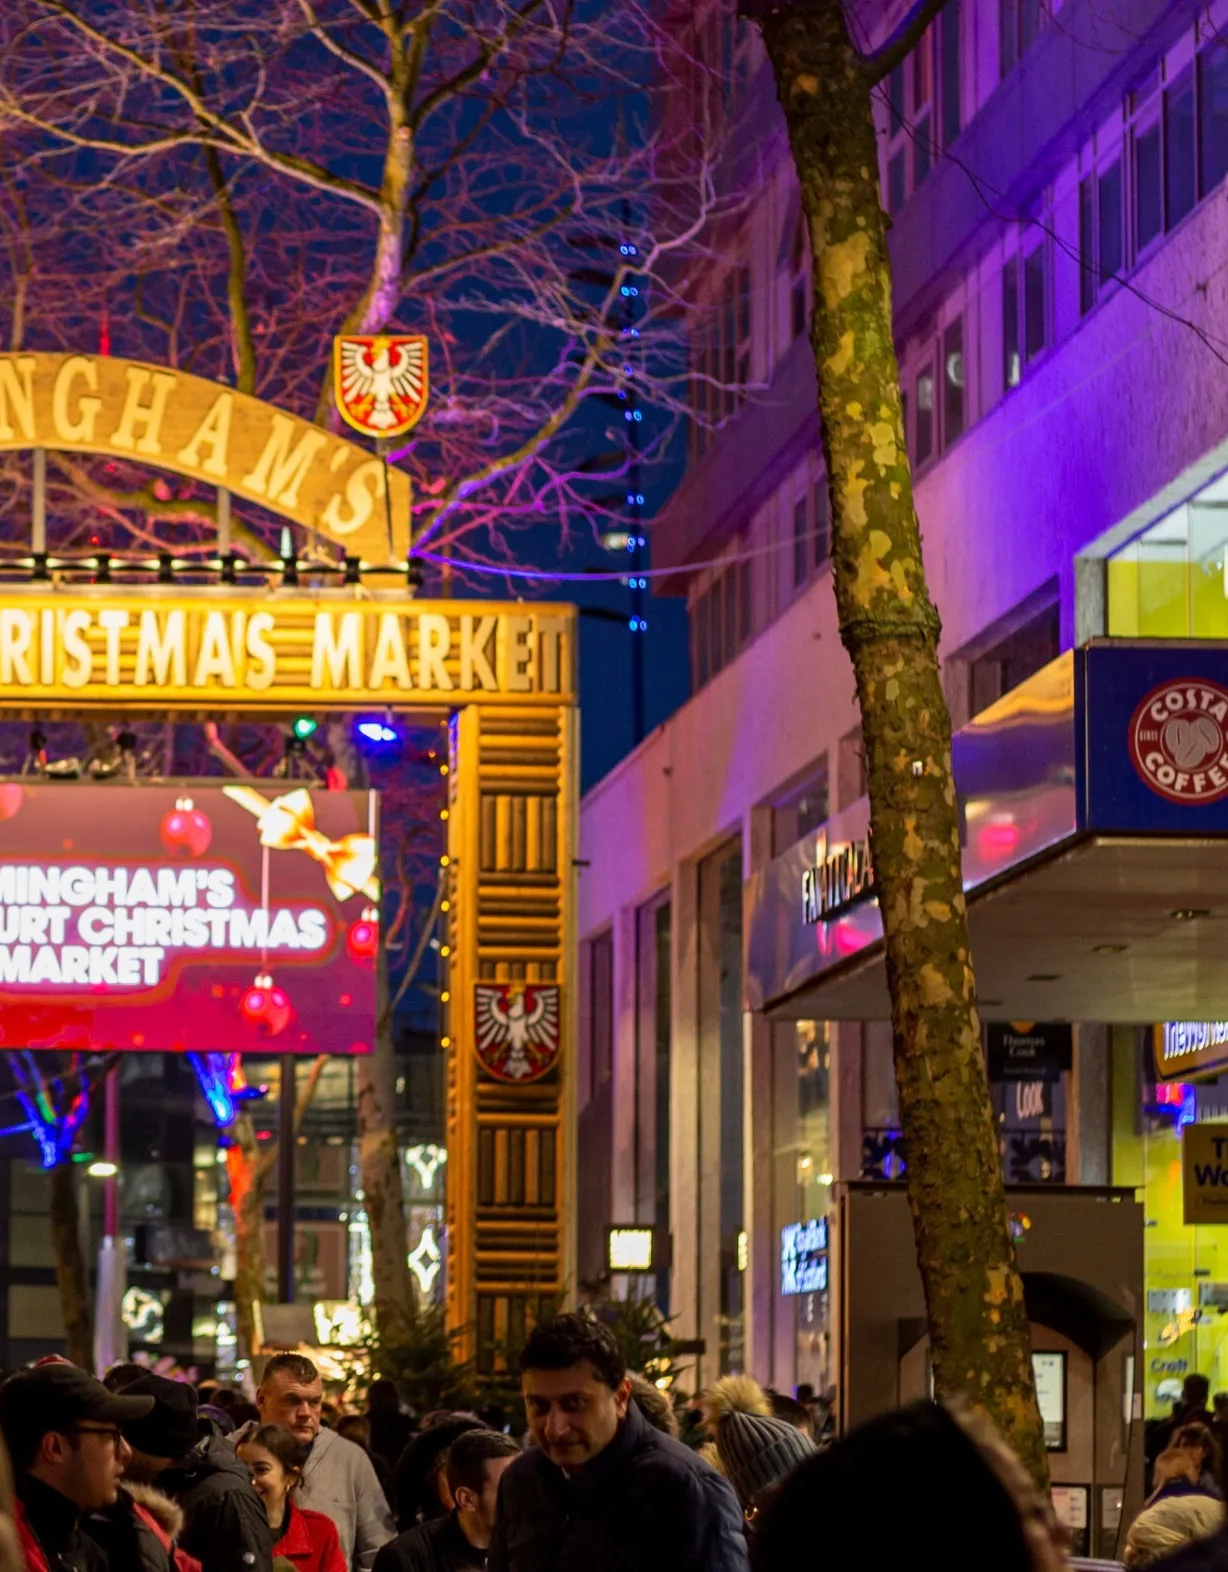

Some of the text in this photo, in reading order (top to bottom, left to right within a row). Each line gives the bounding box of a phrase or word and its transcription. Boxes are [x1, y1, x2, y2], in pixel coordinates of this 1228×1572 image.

[309, 612, 568, 691] MARKET
[1150, 688, 1228, 723] COSTA
[77, 906, 327, 950] CHRISTMAS
